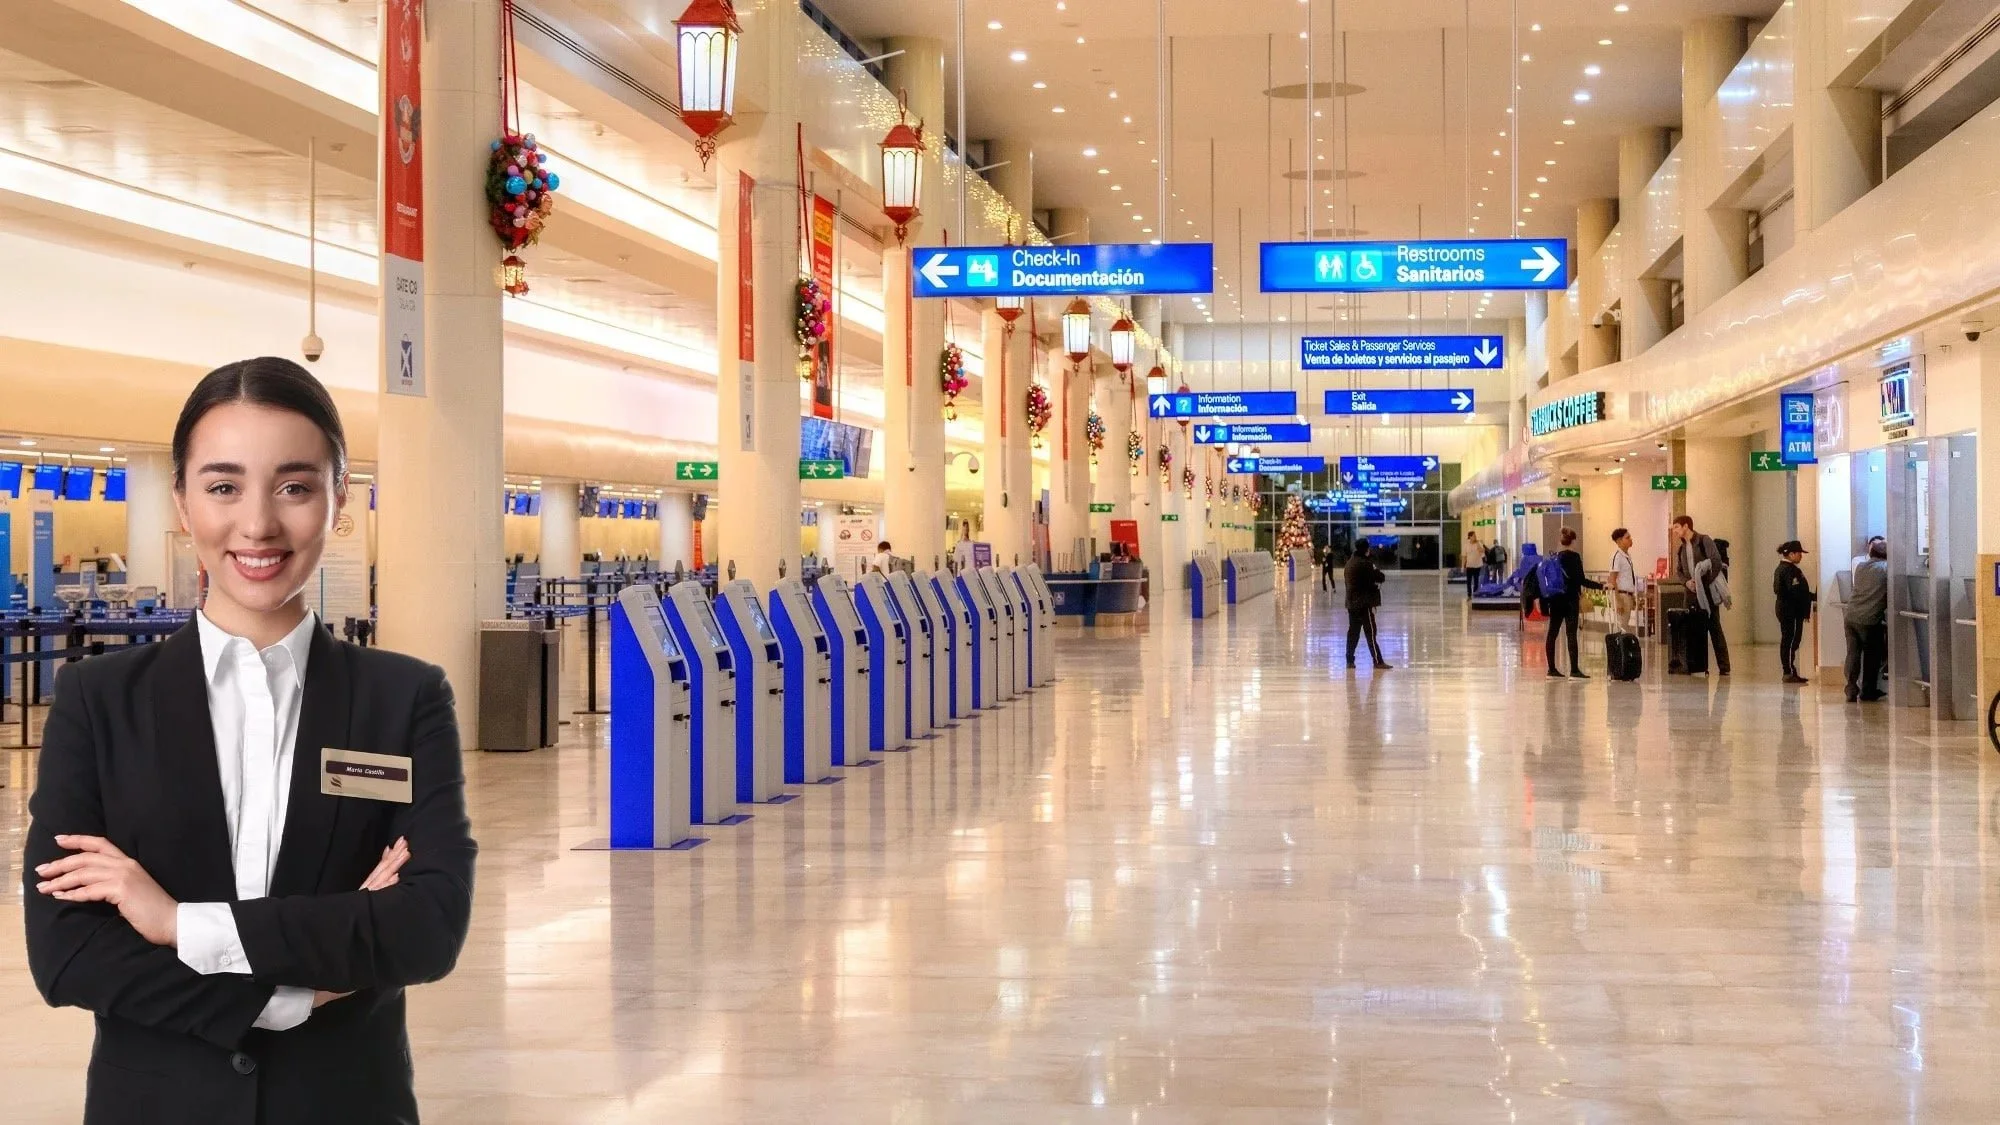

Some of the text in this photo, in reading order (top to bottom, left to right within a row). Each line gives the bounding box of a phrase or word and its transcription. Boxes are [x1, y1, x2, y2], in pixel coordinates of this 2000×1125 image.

[1012, 249, 1080, 267] Check-In
[1397, 244, 1485, 263] Restrooms
[1012, 269, 1145, 287] Documentación
[1396, 264, 1485, 283] Sanitarios
[1304, 339, 1436, 353] Ticket Sales & Passenger Services
[1304, 352, 1470, 367] Venta de boletos y servicios al pasajero
[1198, 394, 1242, 404] Information
[1351, 391, 1367, 402] Exit
[1198, 403, 1248, 413] Información
[1351, 402, 1377, 411] Salida
[1563, 391, 1598, 429] COFFEE
[1231, 425, 1267, 434] Information
[1231, 433, 1273, 441] Información
[1788, 441, 1812, 453] ATM
